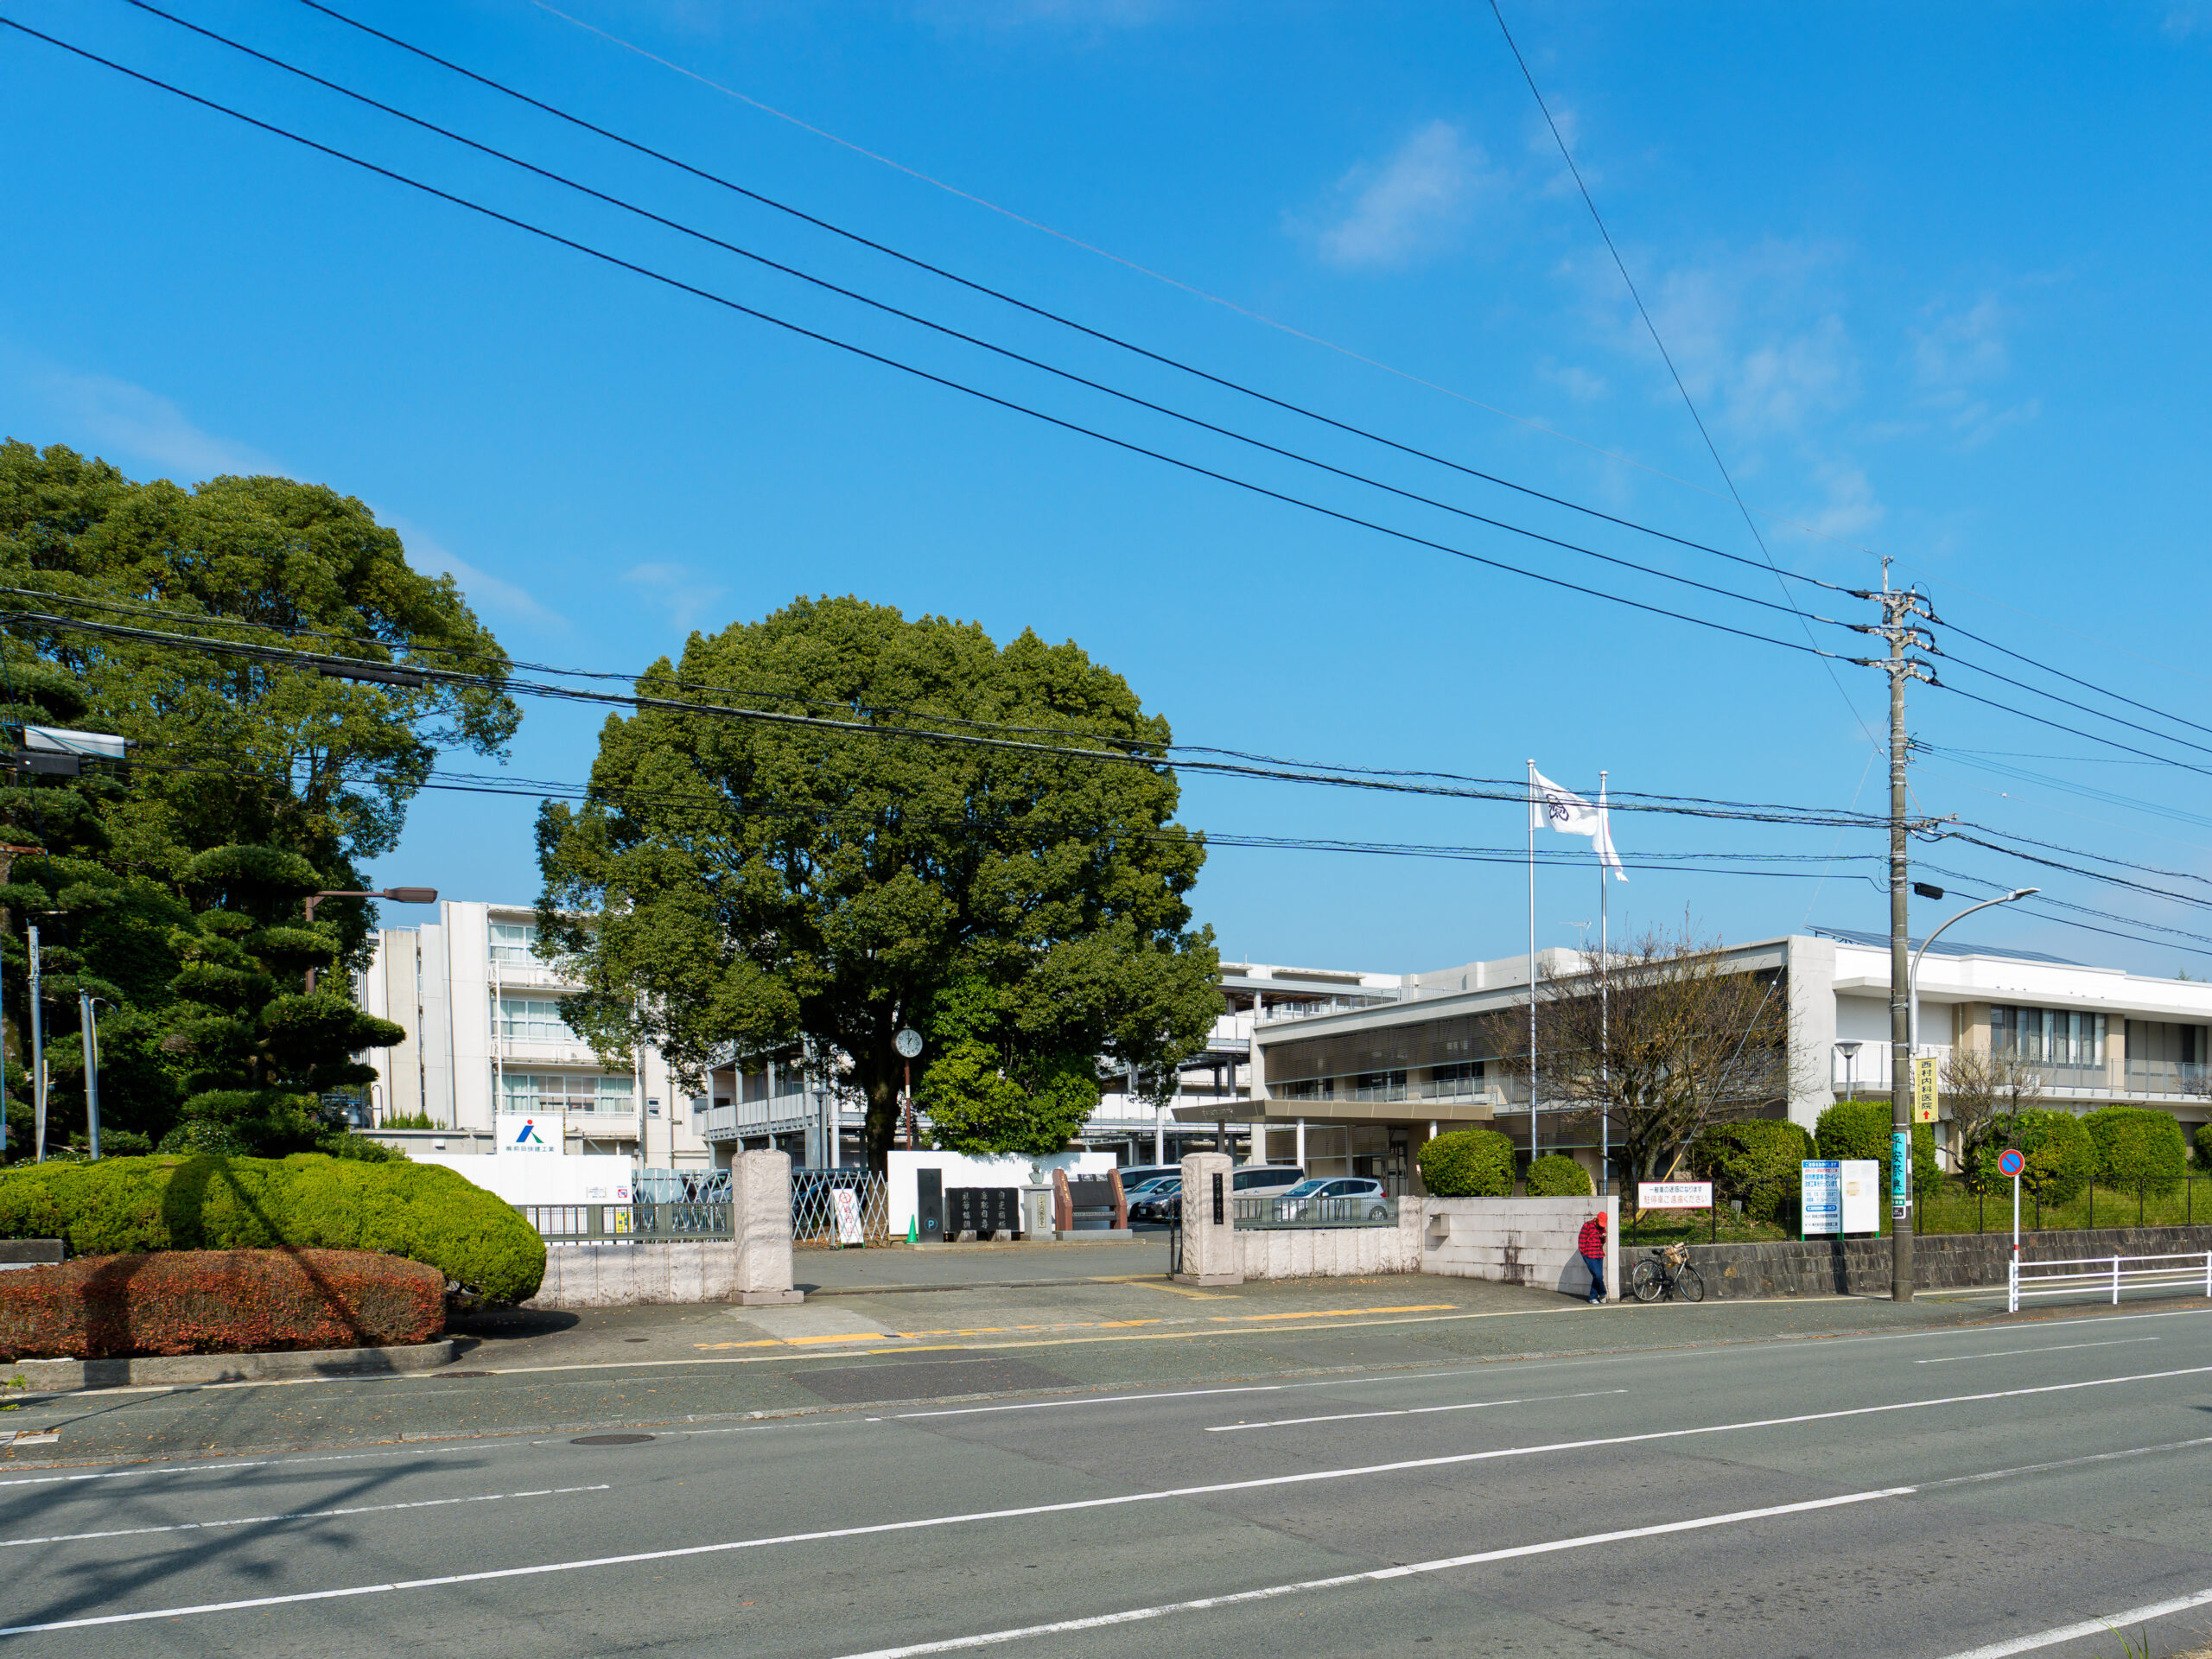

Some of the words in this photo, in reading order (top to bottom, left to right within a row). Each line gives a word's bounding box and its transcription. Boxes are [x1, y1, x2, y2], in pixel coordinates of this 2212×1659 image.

[1921, 1060, 1933, 1110] 西村内科医院
[1892, 1135, 1903, 1191] 平安祭典
[1643, 1195, 1708, 1204] 駐停車ご遠慮ください
